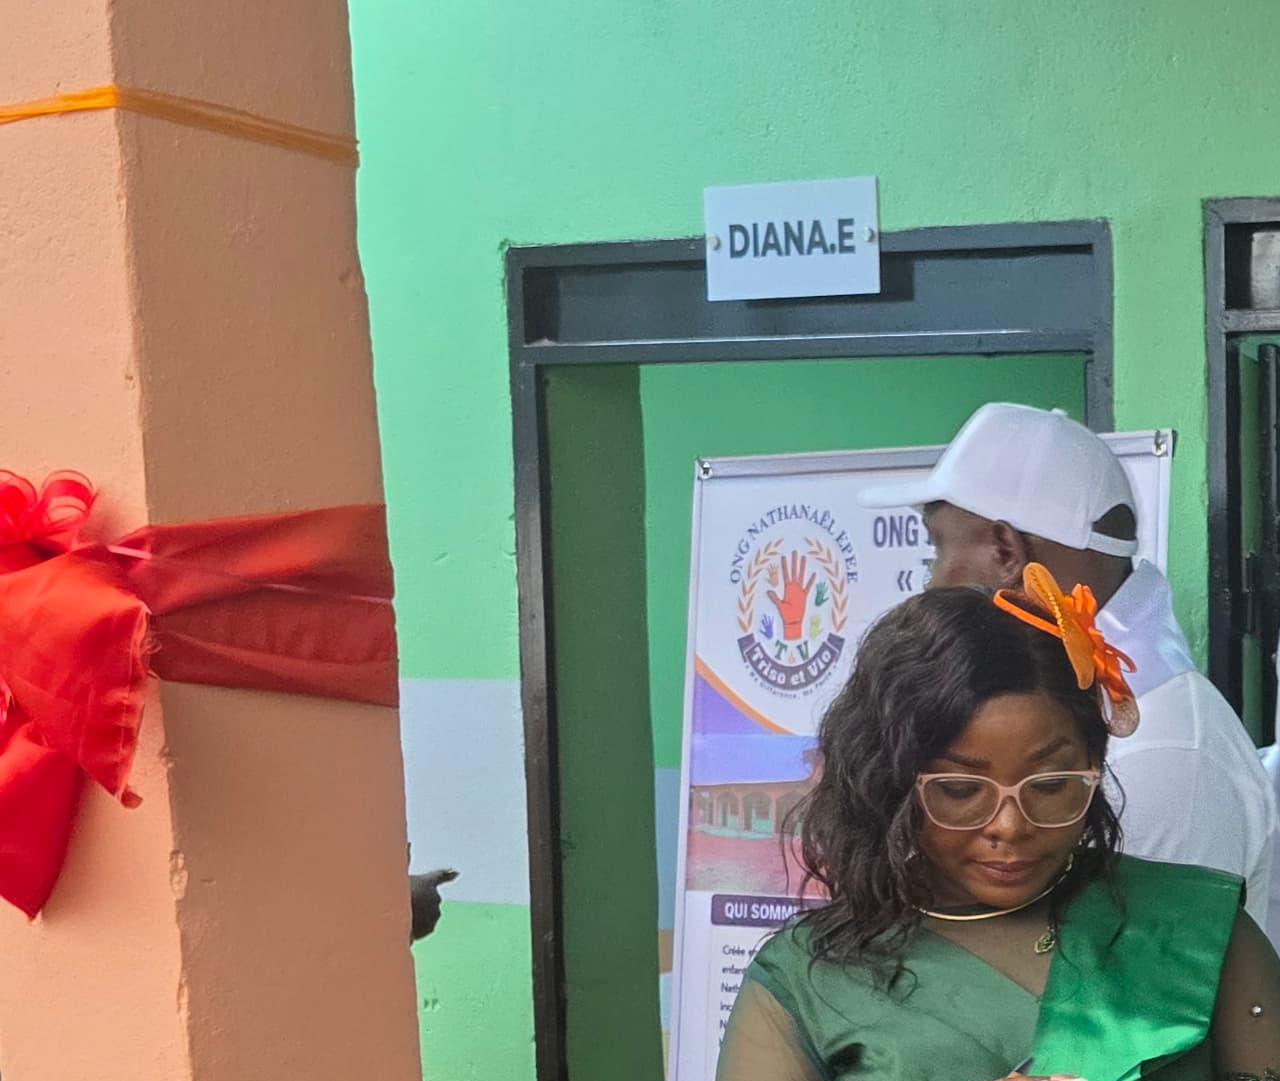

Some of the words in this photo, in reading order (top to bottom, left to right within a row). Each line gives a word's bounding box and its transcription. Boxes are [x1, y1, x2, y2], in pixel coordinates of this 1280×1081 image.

[729, 218, 855, 259] DIANA.E
[873, 515, 919, 548] ONG
[729, 538, 750, 584] ONG
[775, 640, 788, 661] T
[797, 640, 809, 661] V
[724, 903, 748, 919] QUI
